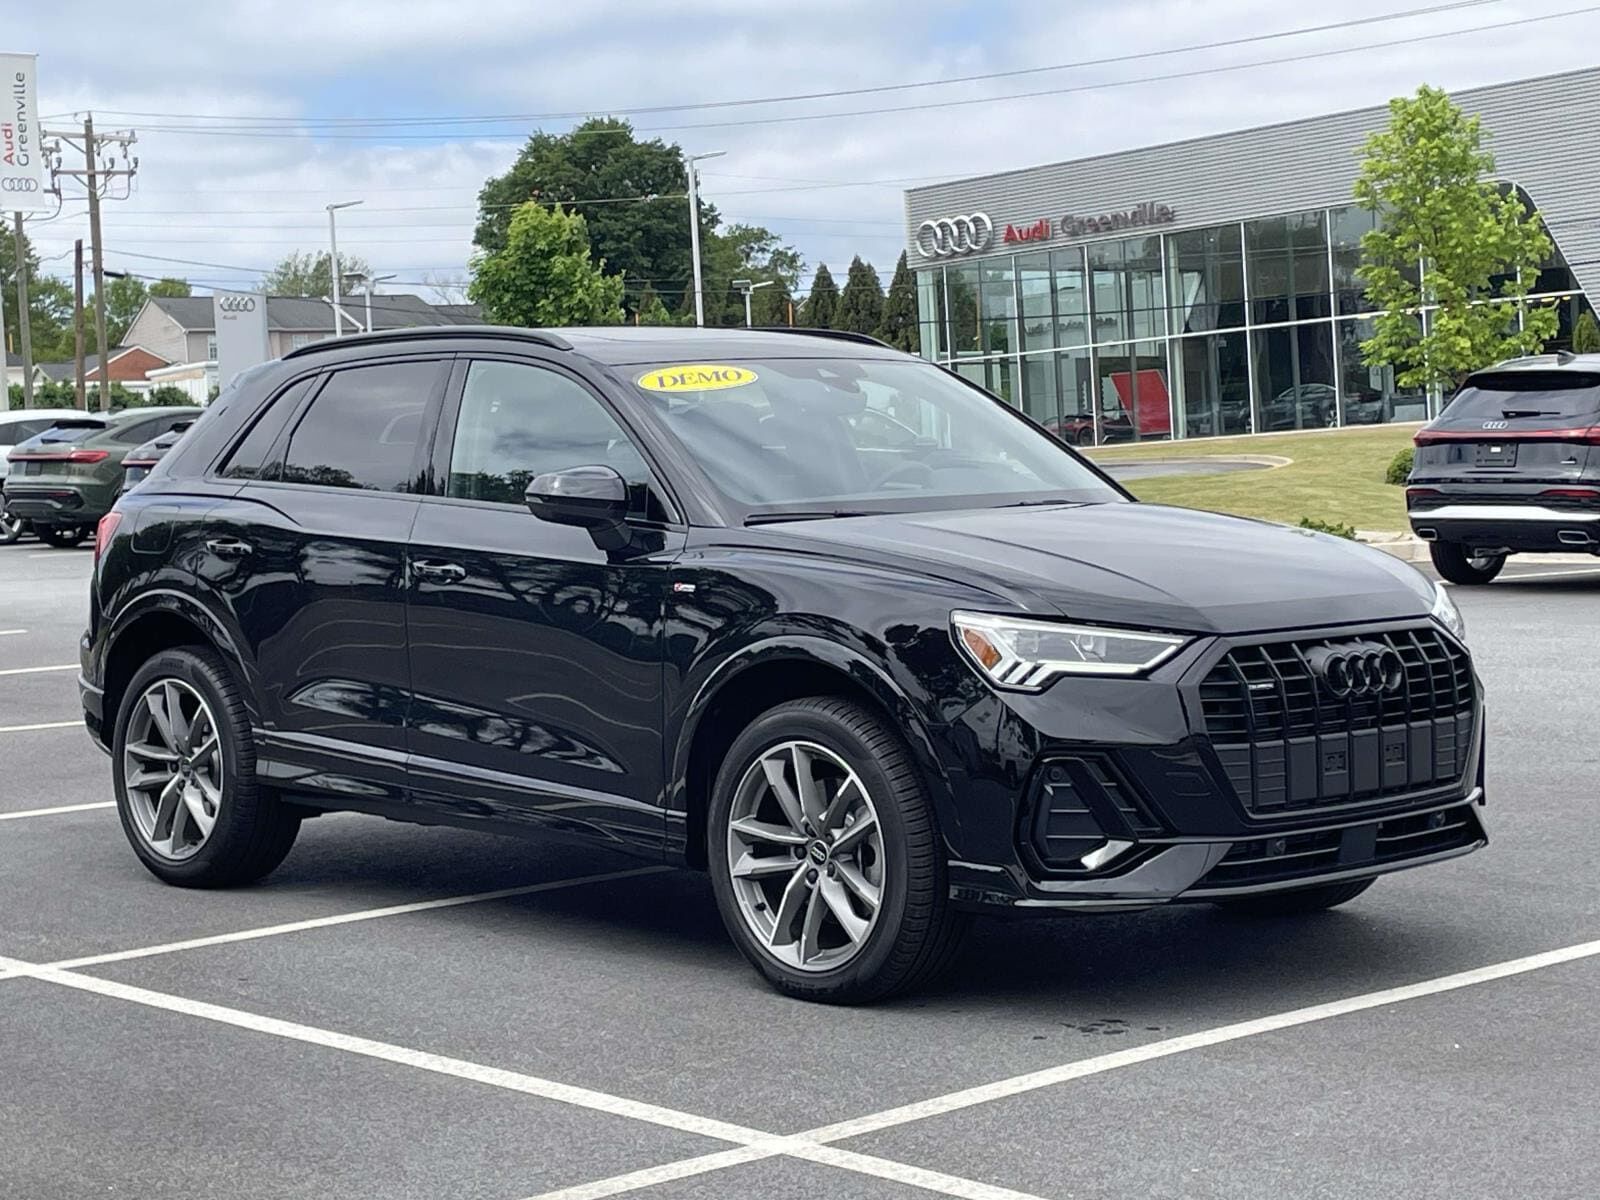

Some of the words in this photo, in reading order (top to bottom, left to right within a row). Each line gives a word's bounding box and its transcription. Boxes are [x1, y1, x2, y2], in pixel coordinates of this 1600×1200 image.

[13, 72, 29, 167] Greenville
[1, 122, 14, 166] Audi
[1003, 217, 1050, 243] Audi
[1060, 201, 1174, 235] Greenville
[657, 370, 742, 387] DEMO
